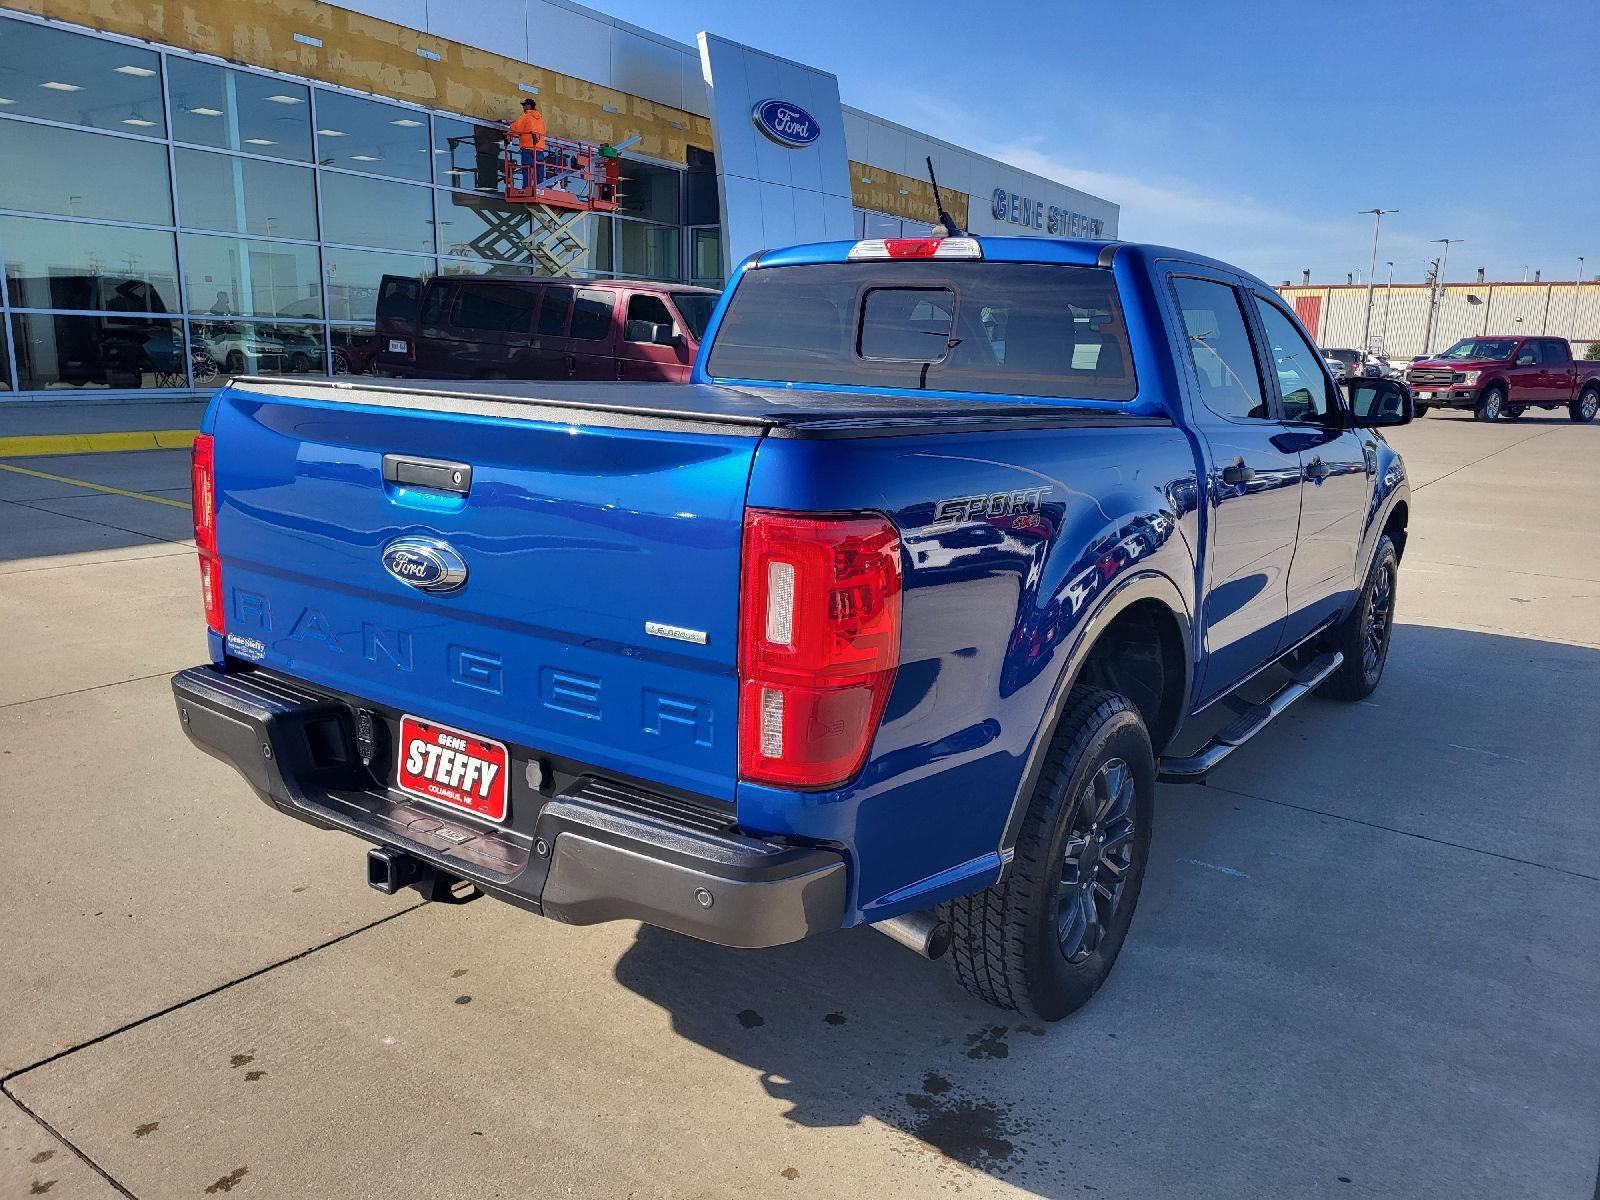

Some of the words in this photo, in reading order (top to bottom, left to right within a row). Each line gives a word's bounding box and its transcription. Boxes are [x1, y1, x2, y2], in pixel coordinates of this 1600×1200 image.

[775, 108, 809, 137] Ford
[993, 188, 1044, 230] GENE
[1047, 205, 1105, 238] STEFFY
[933, 485, 1053, 525] SPORT
[392, 551, 428, 578] Ford
[232, 587, 716, 748] RANGER
[438, 733, 467, 751] GENE
[405, 738, 499, 799] STEFFY
[428, 784, 462, 802] COLUMBUS,
[463, 795, 473, 805] NE
